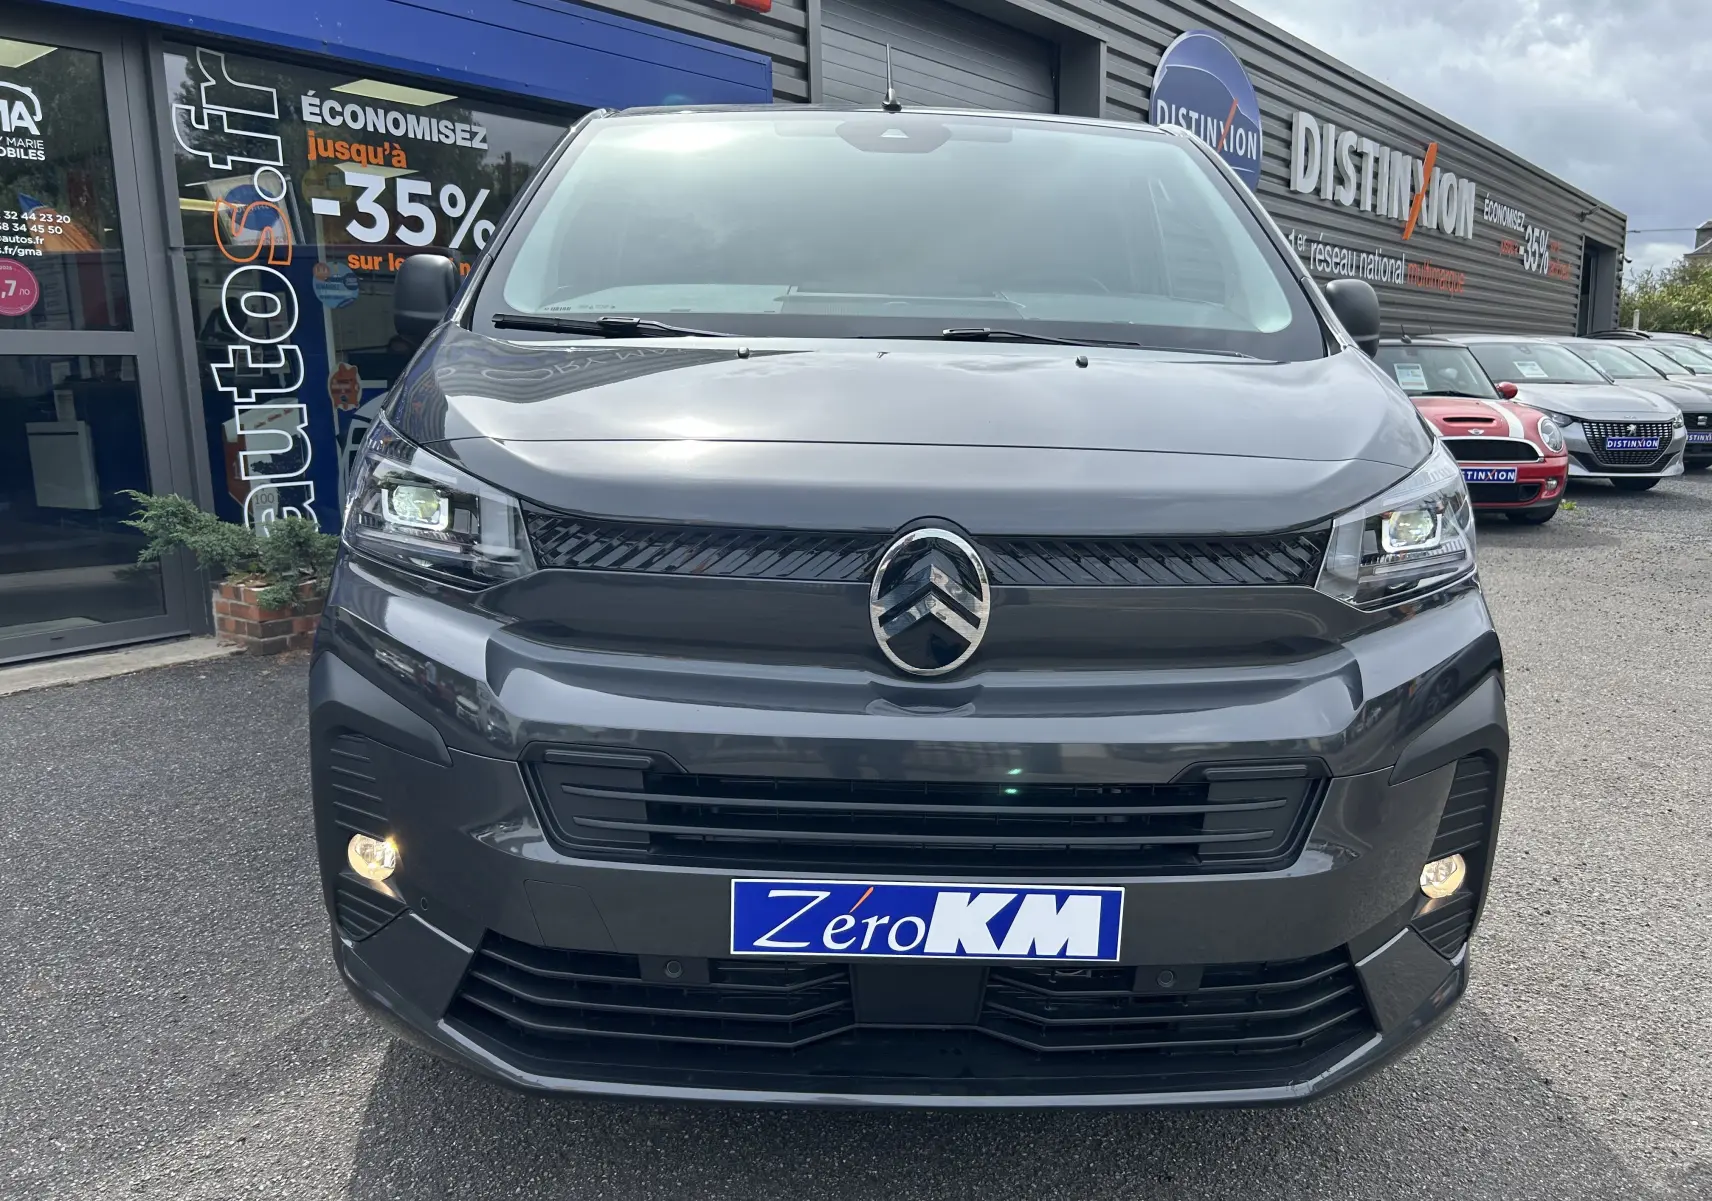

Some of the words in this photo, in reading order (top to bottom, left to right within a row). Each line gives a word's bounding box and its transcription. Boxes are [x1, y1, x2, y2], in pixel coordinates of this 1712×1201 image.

[301, 90, 488, 150] ÉCONOMISEZ
[1157, 97, 1257, 160] DISTINXION
[7, 137, 44, 149] MARIE
[307, 130, 407, 167] jusqu'à
[1290, 111, 1476, 240] DISTINXION
[4, 210, 18, 219] 32
[21, 212, 36, 220] 44
[40, 214, 53, 222] 23
[56, 215, 71, 223] 20
[12, 223, 27, 231] 34
[30, 225, 45, 233] 45
[48, 226, 62, 234] 50
[312, 171, 496, 250] -35%
[1483, 193, 1525, 232] ÉCONOMISEZ
[0, 235, 44, 245] autos.fr
[1310, 232, 1357, 277] réseau
[1359, 248, 1405, 285] national
[1519, 225, 1549, 275] -35%
[347, 254, 383, 270] sur
[172, 47, 318, 538] autos.fr
[1606, 438, 1659, 449] DISTINXION
